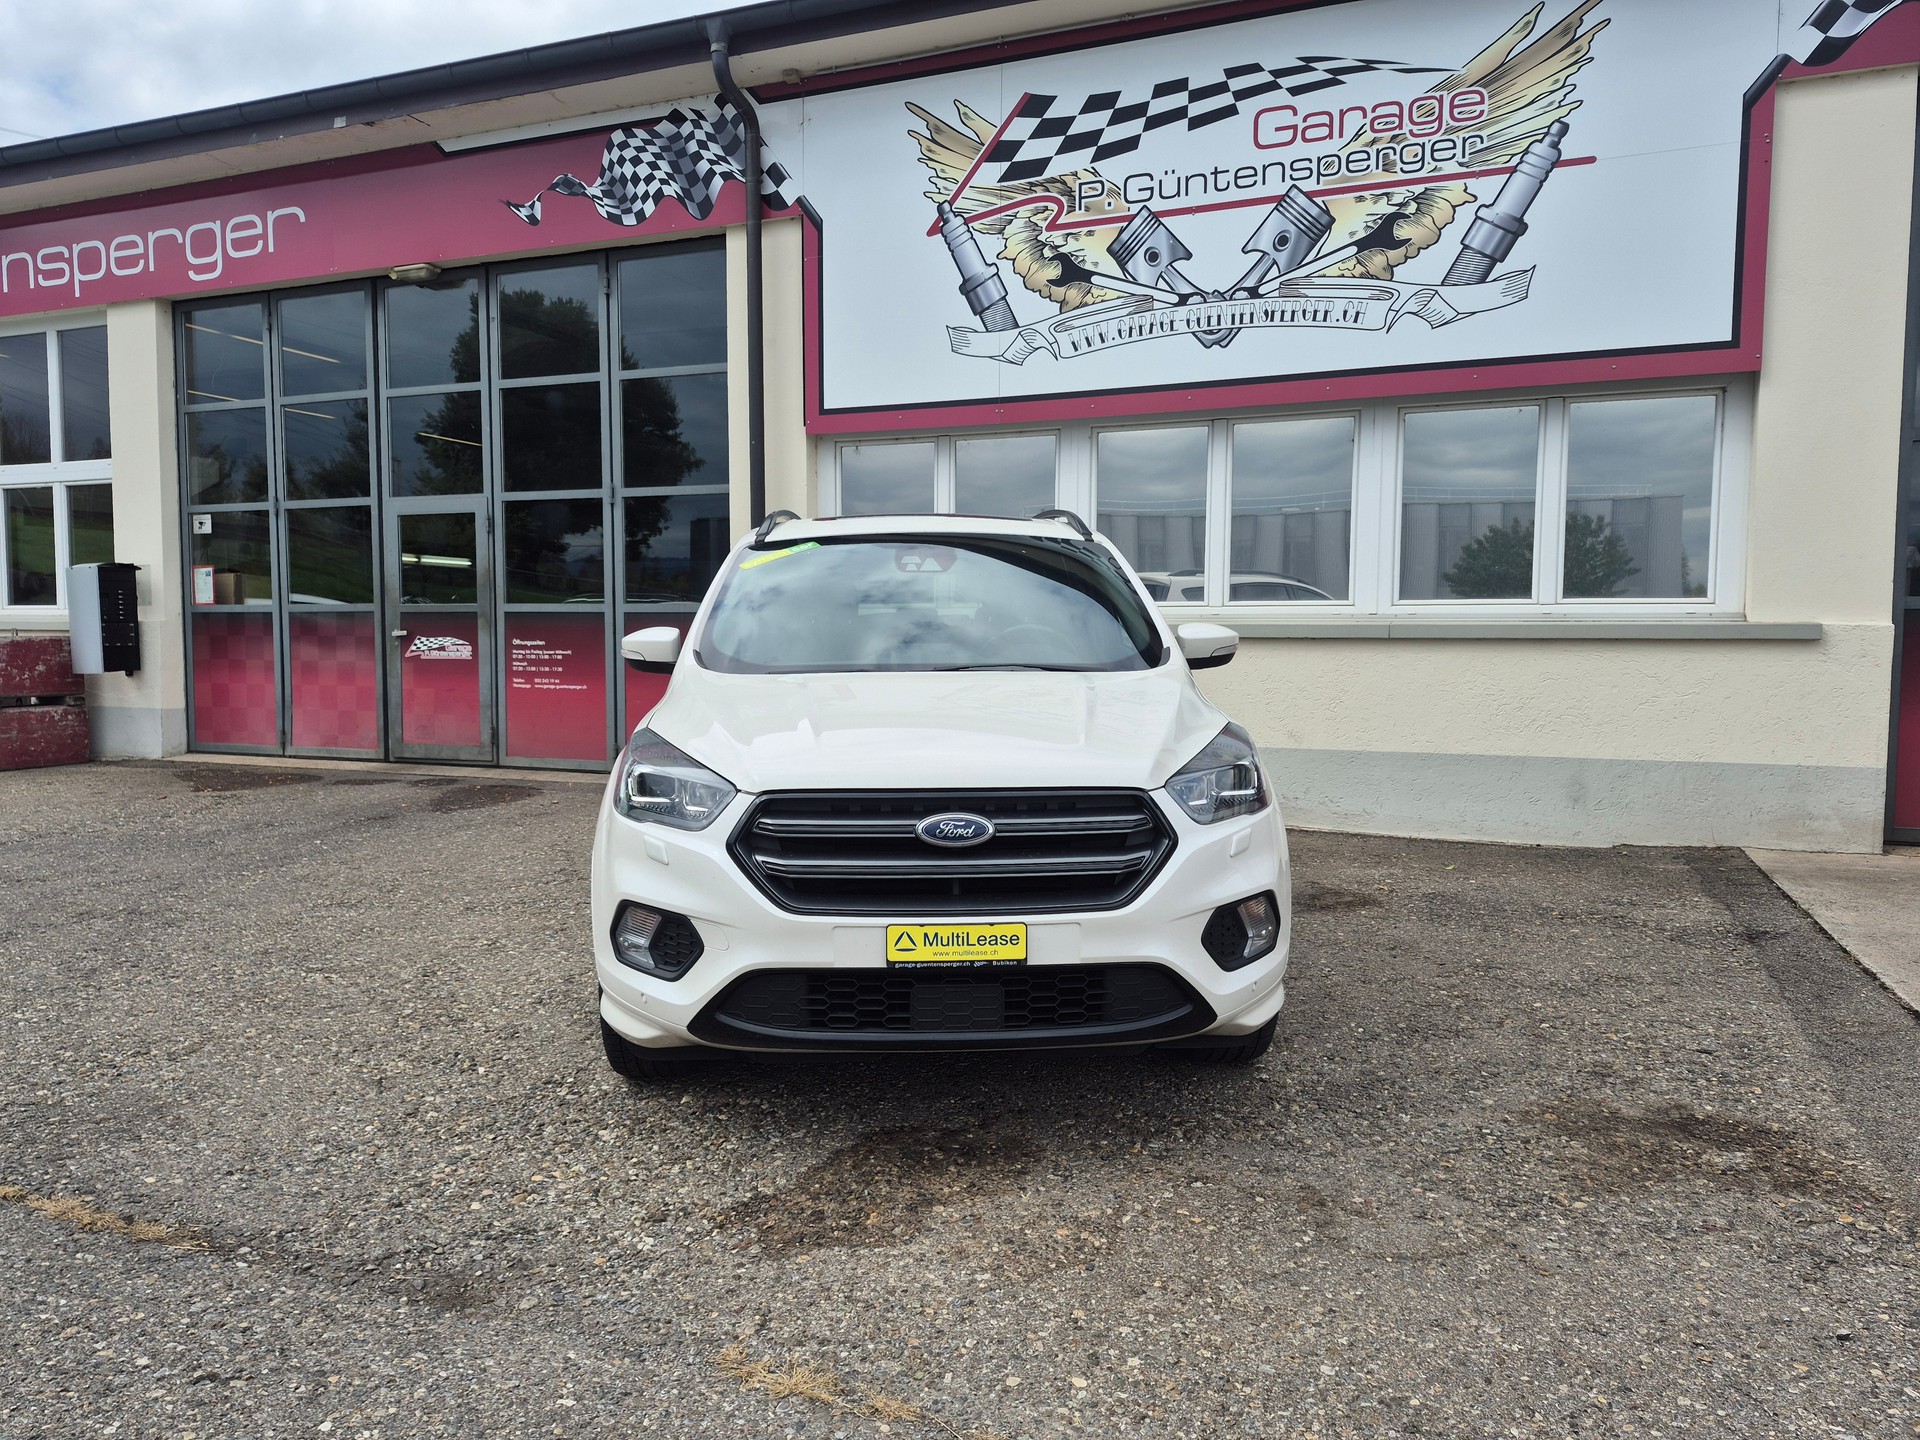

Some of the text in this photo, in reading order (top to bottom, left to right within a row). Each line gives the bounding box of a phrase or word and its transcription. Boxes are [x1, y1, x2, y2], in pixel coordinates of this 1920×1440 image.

[1252, 85, 1489, 151] Garage
[1076, 130, 1486, 212] P. Güntensperger
[1, 205, 306, 298] nsperger
[935, 820, 976, 838] Ford
[923, 931, 1020, 947] MultiLease
[932, 949, 999, 957] www.multilease.ch
